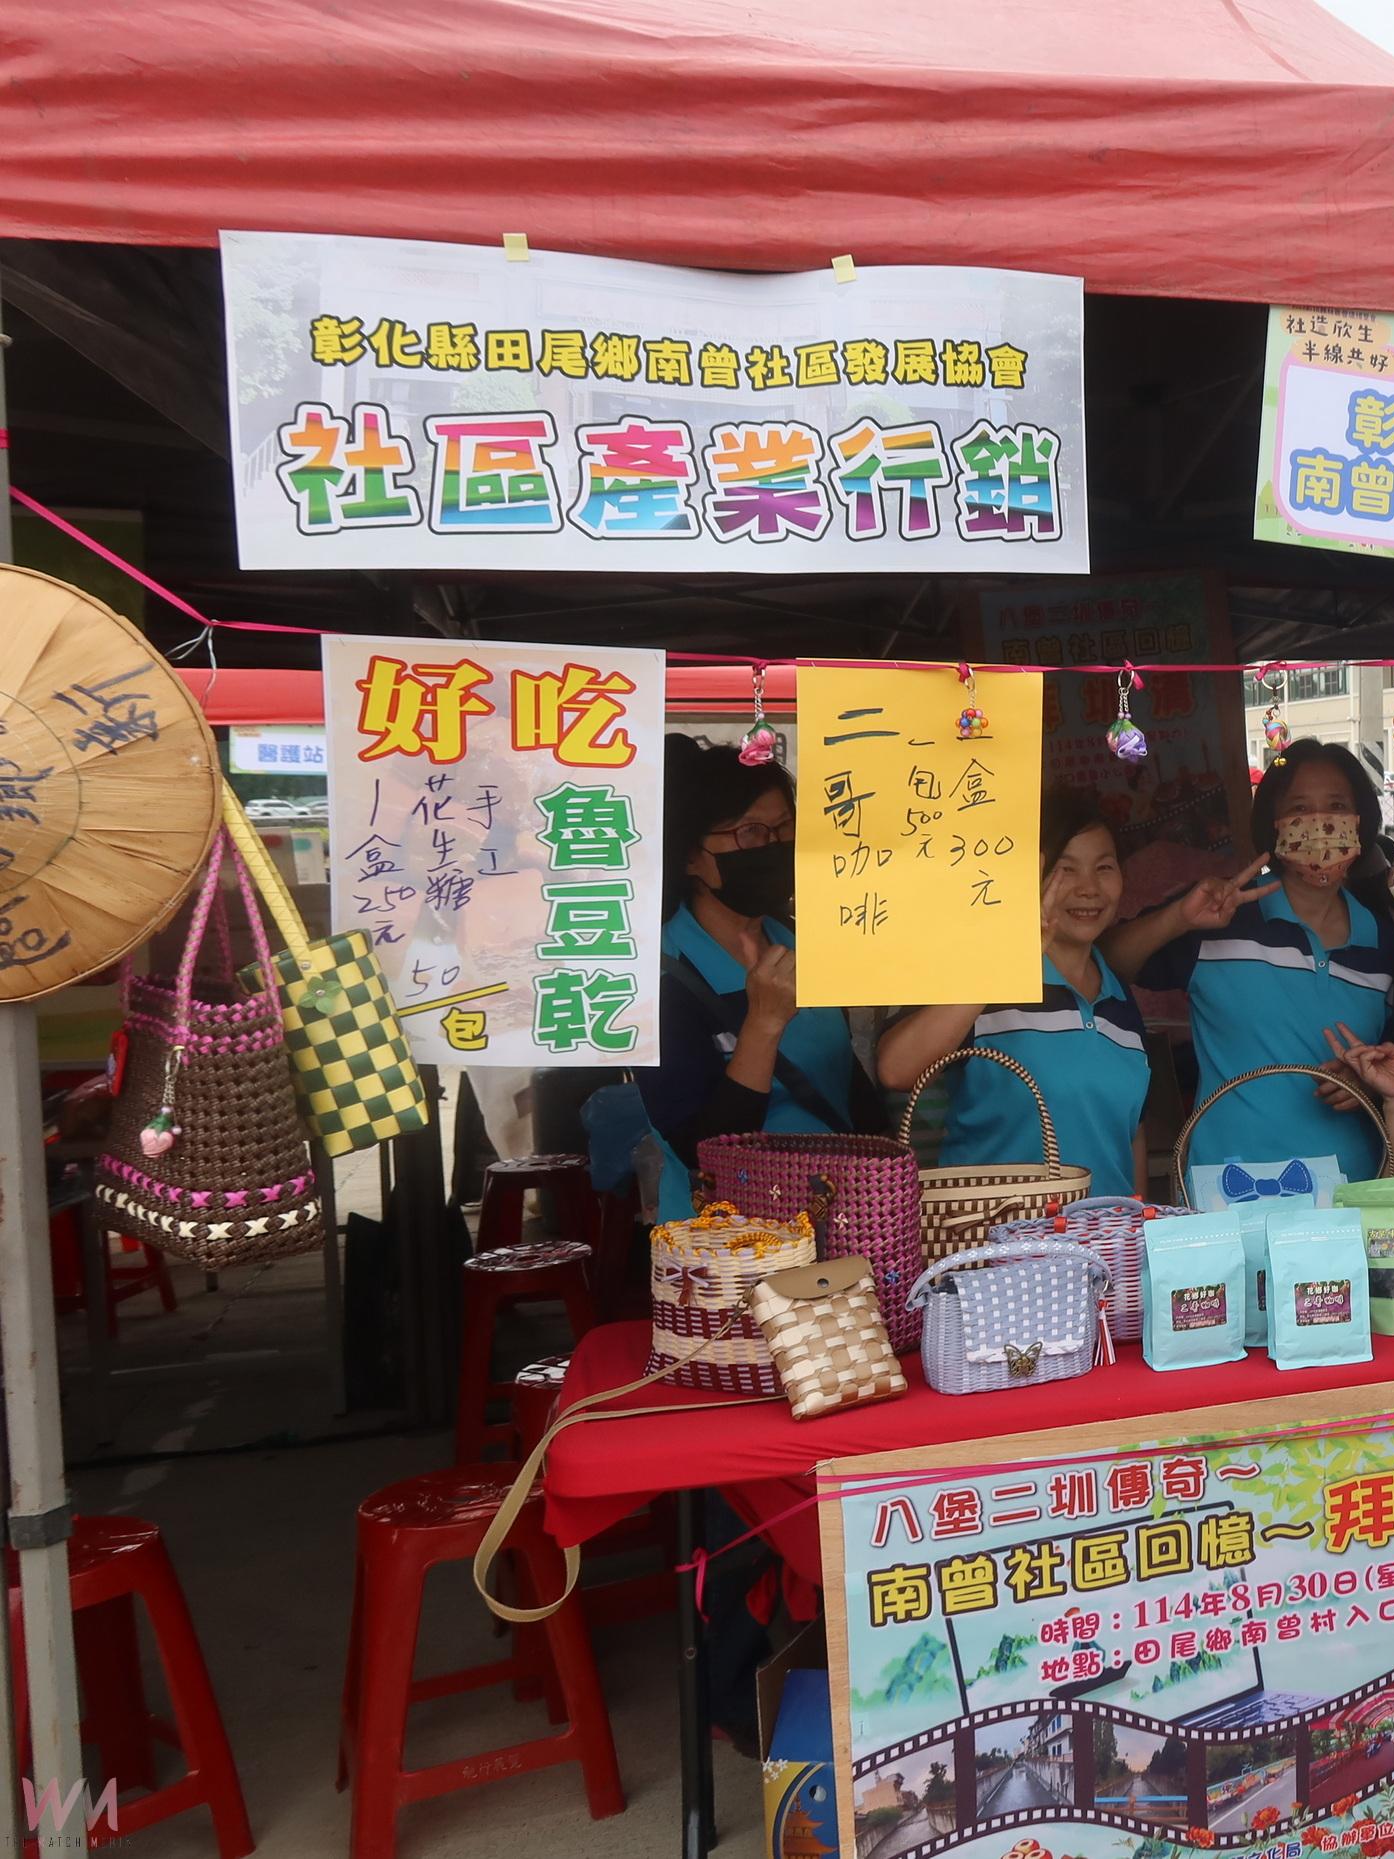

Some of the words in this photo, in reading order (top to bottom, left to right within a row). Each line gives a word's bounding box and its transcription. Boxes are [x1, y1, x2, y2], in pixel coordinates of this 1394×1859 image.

[309, 314, 1029, 390] 彰化縣田尾鄉南曾社區發展協會
[1286, 314, 1374, 343] 社造欣生
[1302, 340, 1389, 373] 半線共好
[277, 403, 1064, 543] 社區產業行銷
[356, 655, 637, 768] 好吃
[823, 707, 902, 936] 二哥咖啡
[532, 781, 641, 1054] 魯豆乾
[439, 1007, 489, 1051] 包
